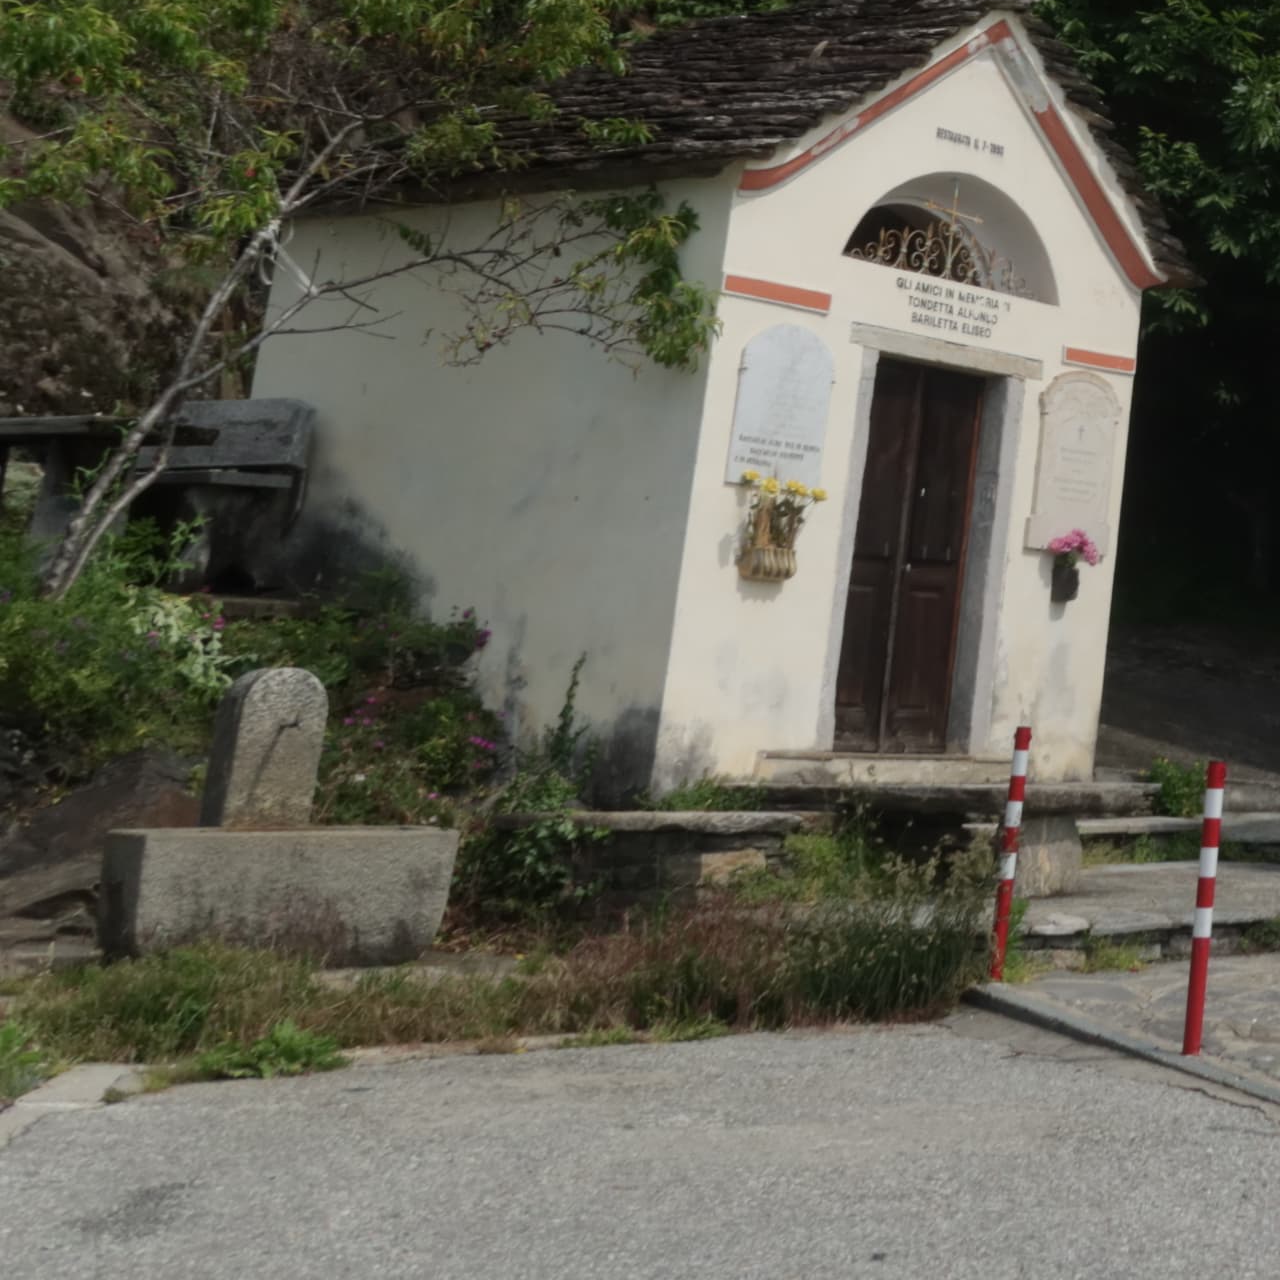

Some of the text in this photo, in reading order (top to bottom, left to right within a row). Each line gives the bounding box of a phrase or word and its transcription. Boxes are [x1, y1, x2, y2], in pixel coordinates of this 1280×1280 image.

[896, 277, 912, 290] GLI
[914, 281, 943, 297] AMICI
[945, 287, 955, 300] IN
[961, 322, 992, 338] ELISEO
